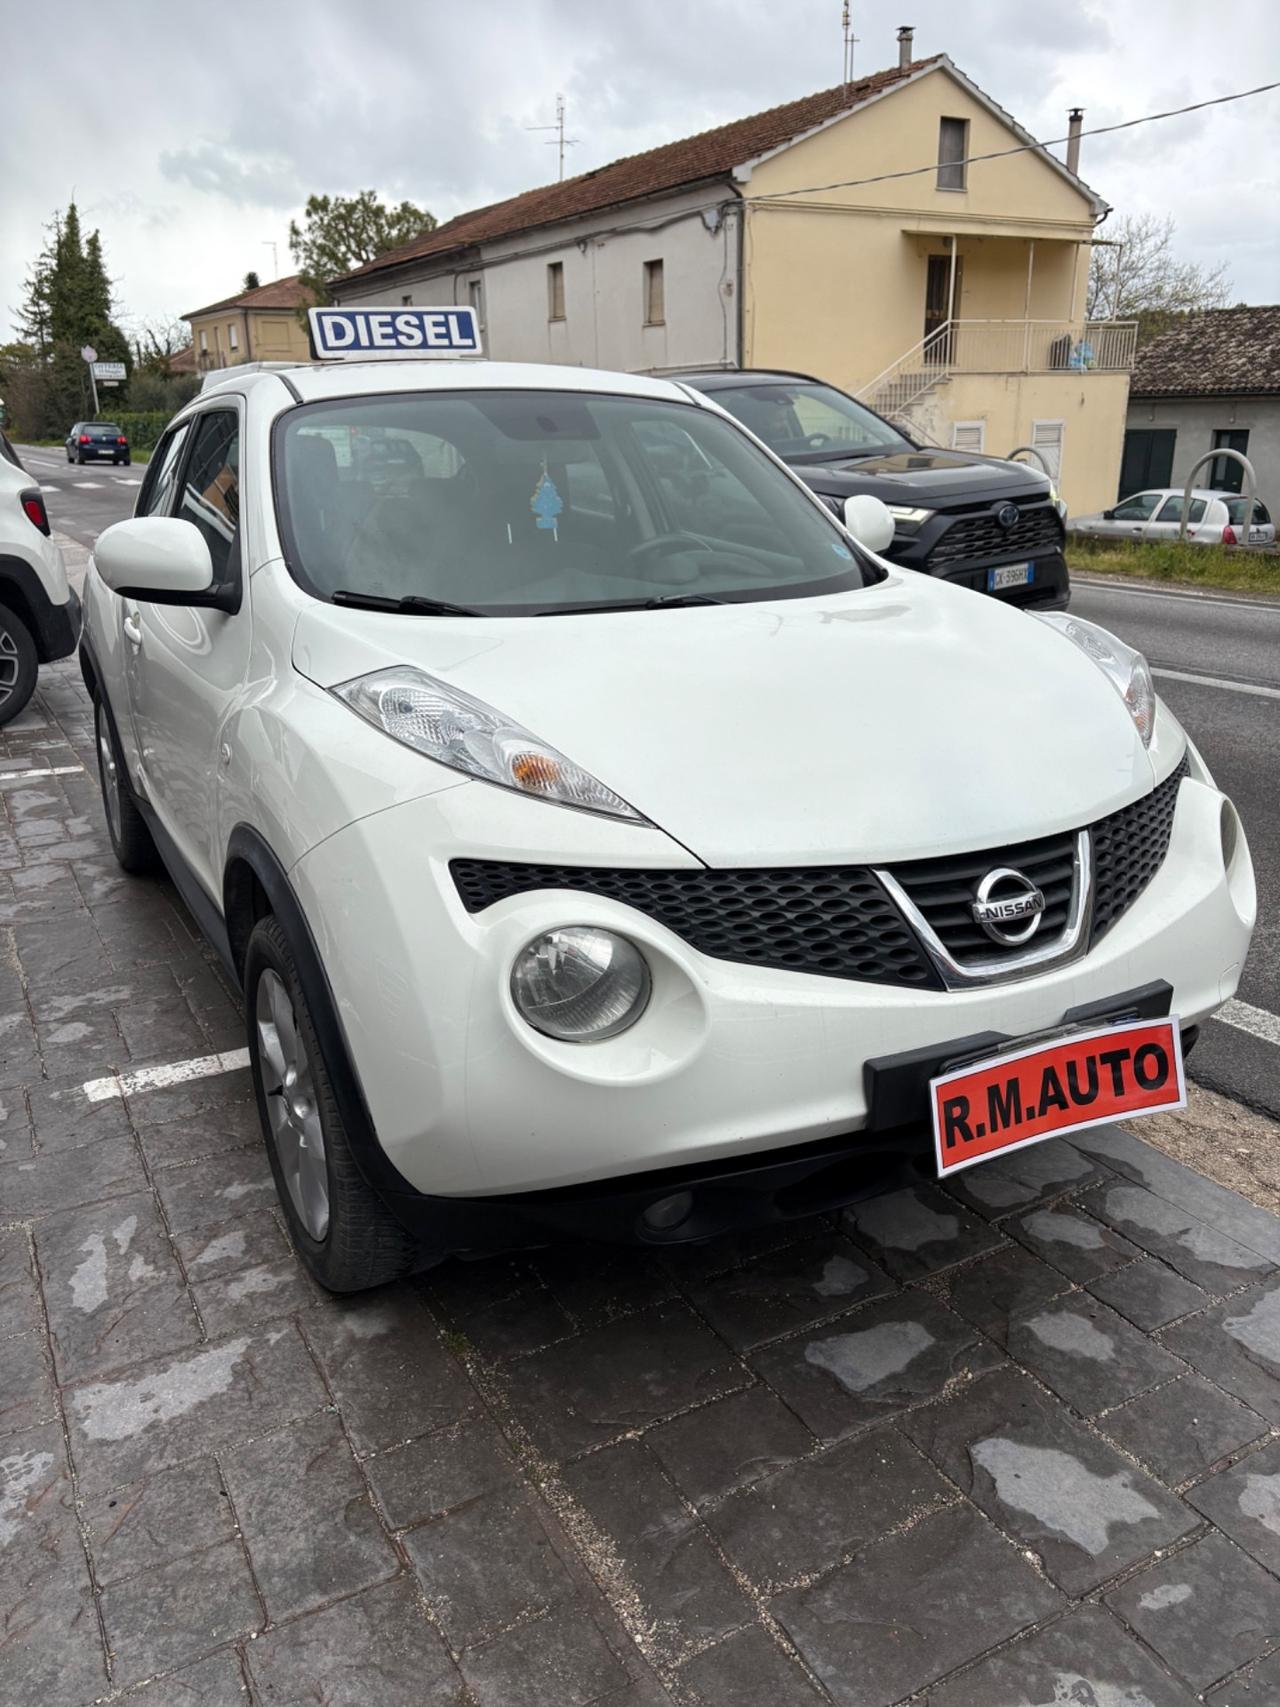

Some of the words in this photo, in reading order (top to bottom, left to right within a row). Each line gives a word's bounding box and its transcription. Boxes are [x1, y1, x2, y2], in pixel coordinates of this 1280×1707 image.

[321, 314, 474, 347] DIESEL
[985, 897, 1041, 919] NISSAN
[943, 1043, 1169, 1149] R.M.AUTO
